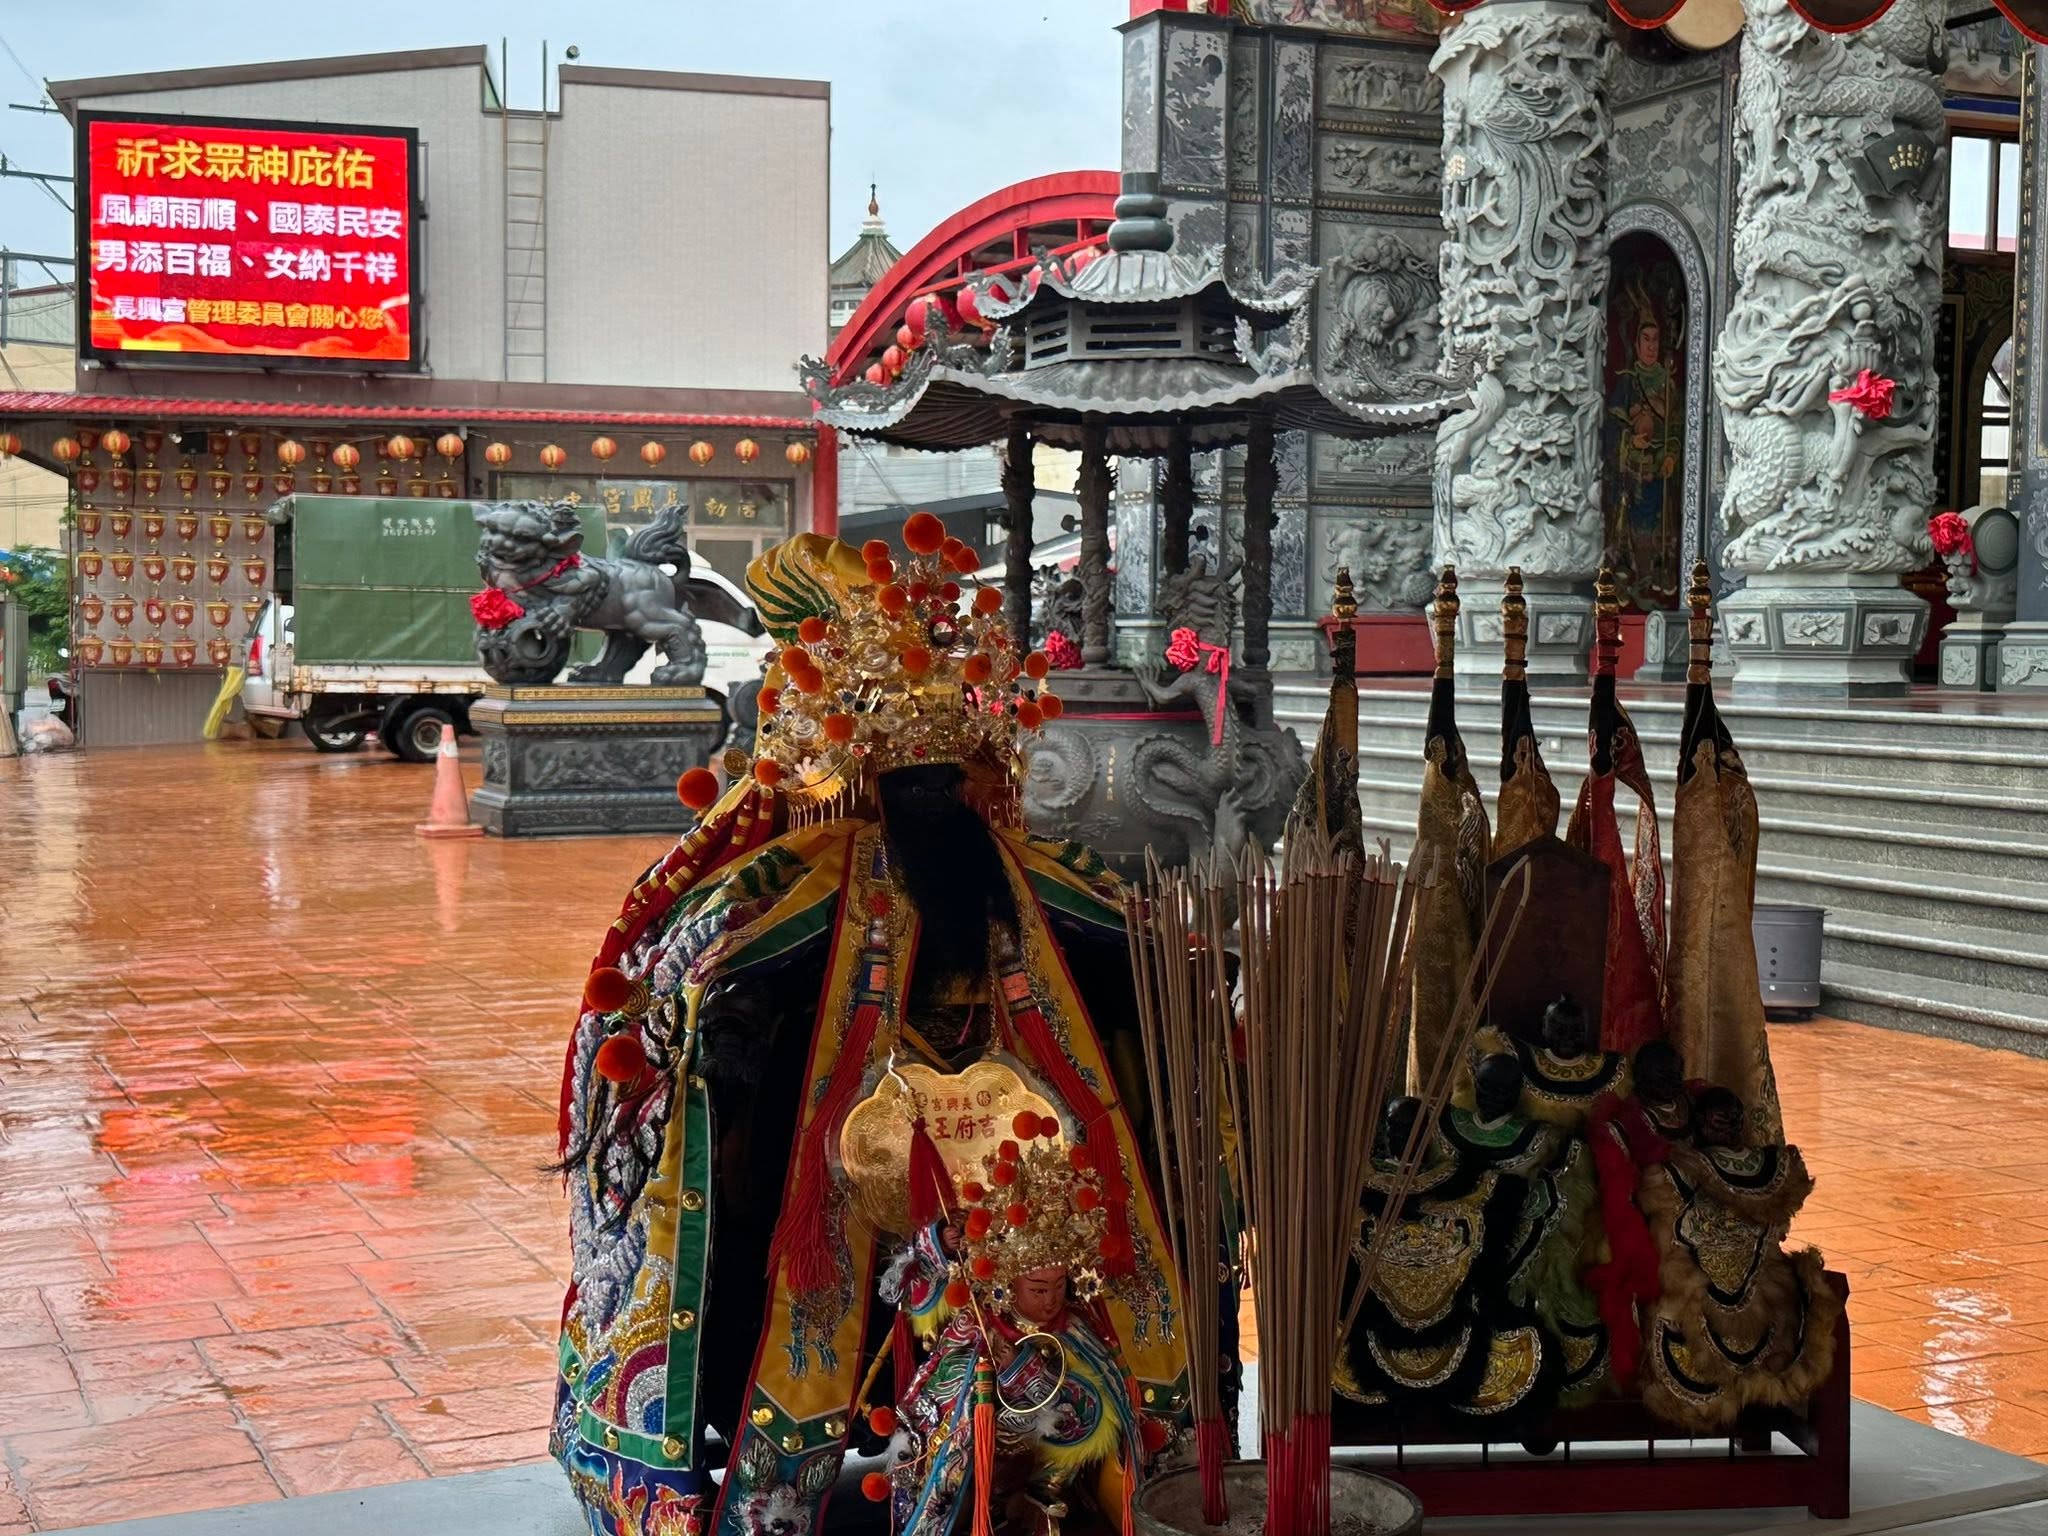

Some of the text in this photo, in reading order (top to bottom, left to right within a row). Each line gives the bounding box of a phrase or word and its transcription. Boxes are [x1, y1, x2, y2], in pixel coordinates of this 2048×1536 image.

[115, 137, 376, 190] 祈求眾神庇佑
[99, 194, 403, 240] 風調雨順、國泰民安
[95, 240, 398, 284] 男添百福、女納千祥
